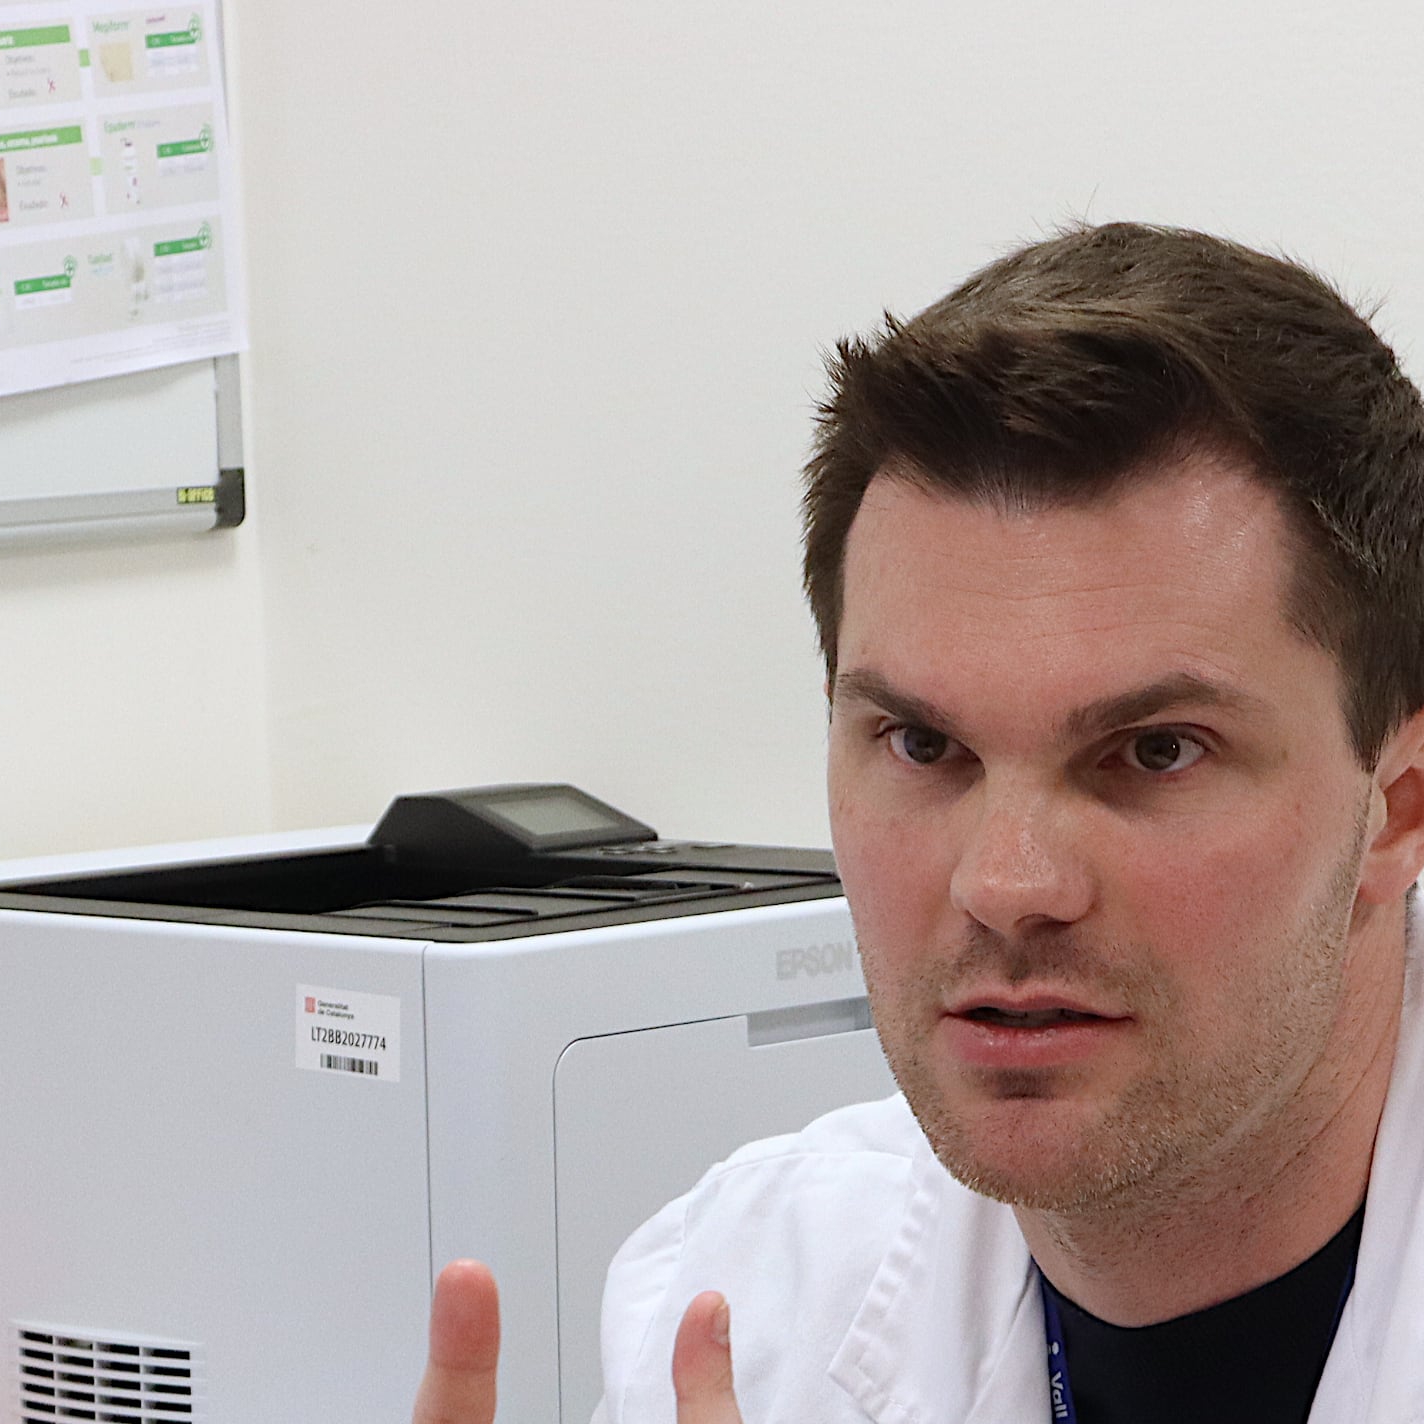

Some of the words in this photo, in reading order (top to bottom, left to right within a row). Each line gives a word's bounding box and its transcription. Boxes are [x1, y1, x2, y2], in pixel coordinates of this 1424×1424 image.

[776, 941, 853, 980] EPSON
[311, 1025, 387, 1051] LT2BB2027774
[1051, 1371, 1069, 1419] Vall
